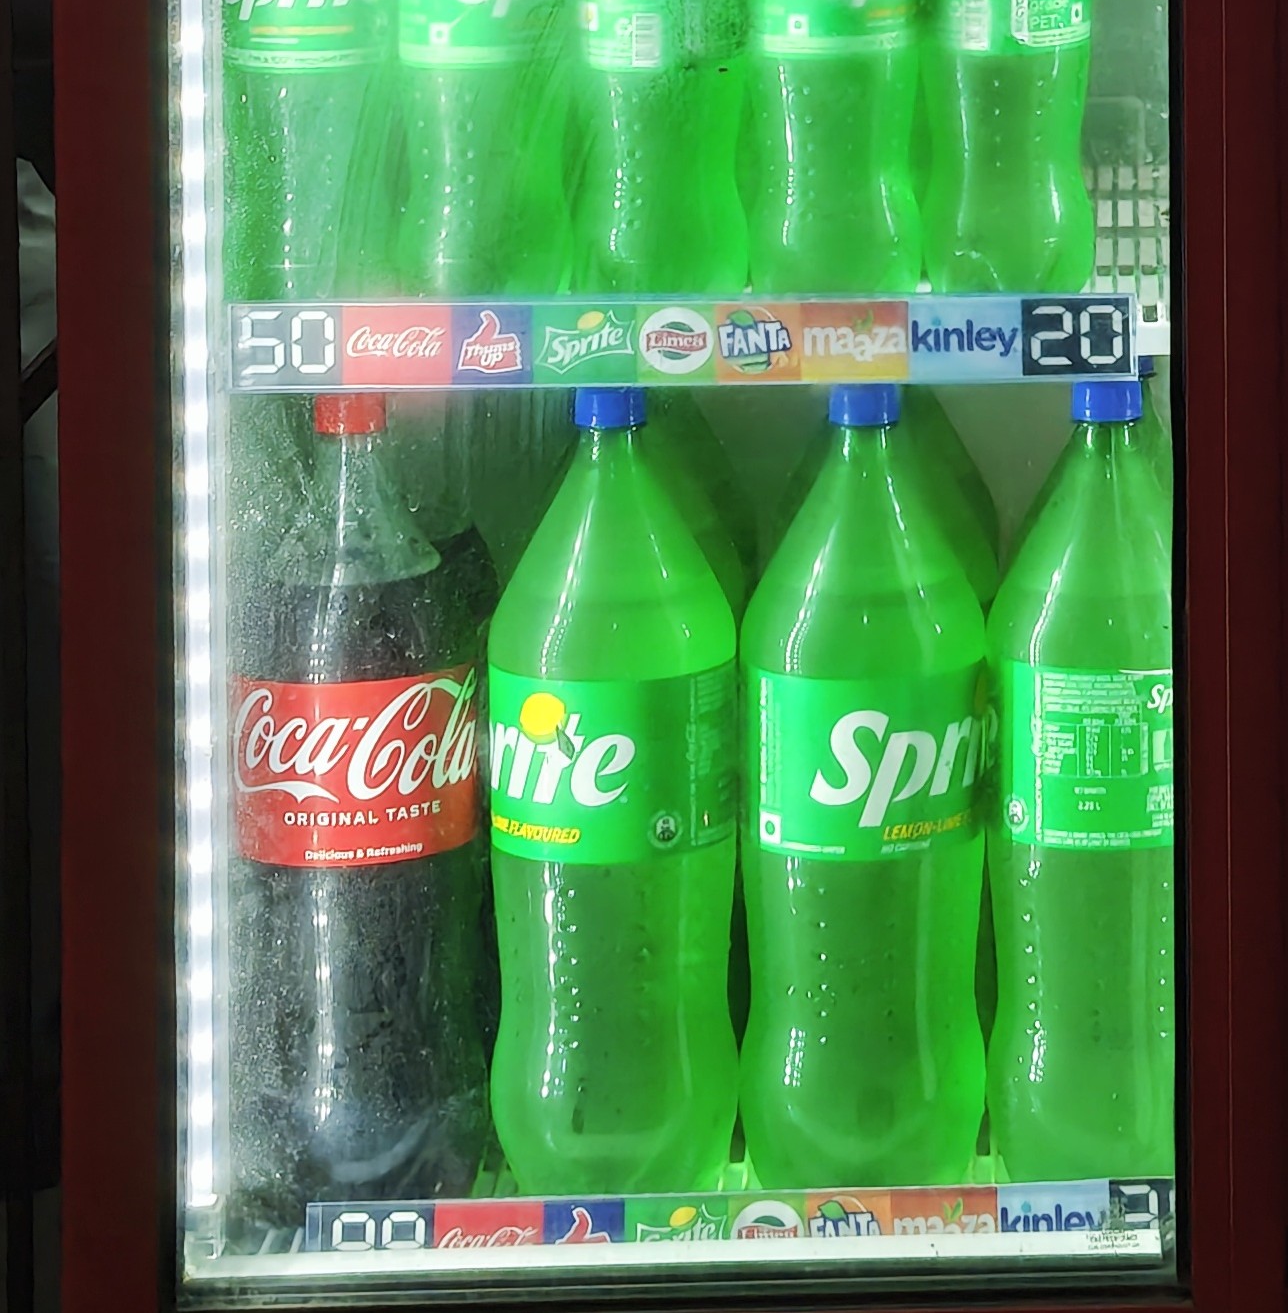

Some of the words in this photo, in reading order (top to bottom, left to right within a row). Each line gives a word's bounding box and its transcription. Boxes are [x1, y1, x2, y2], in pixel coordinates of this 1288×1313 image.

[238, 309, 336, 375] 50
[347, 326, 440, 358] Coca-Cola
[552, 323, 622, 368] Sprite
[650, 333, 704, 347] Limca
[718, 324, 791, 356] FANTA
[804, 325, 907, 362] maaza
[912, 320, 1018, 357] kinley
[1031, 304, 1123, 367] 20
[233, 667, 476, 803] Coca-Cola
[490, 714, 636, 807] rite
[283, 807, 378, 828] ORIGINAL
[386, 799, 442, 822] TASTE
[508, 820, 581, 844] FLAVOURED
